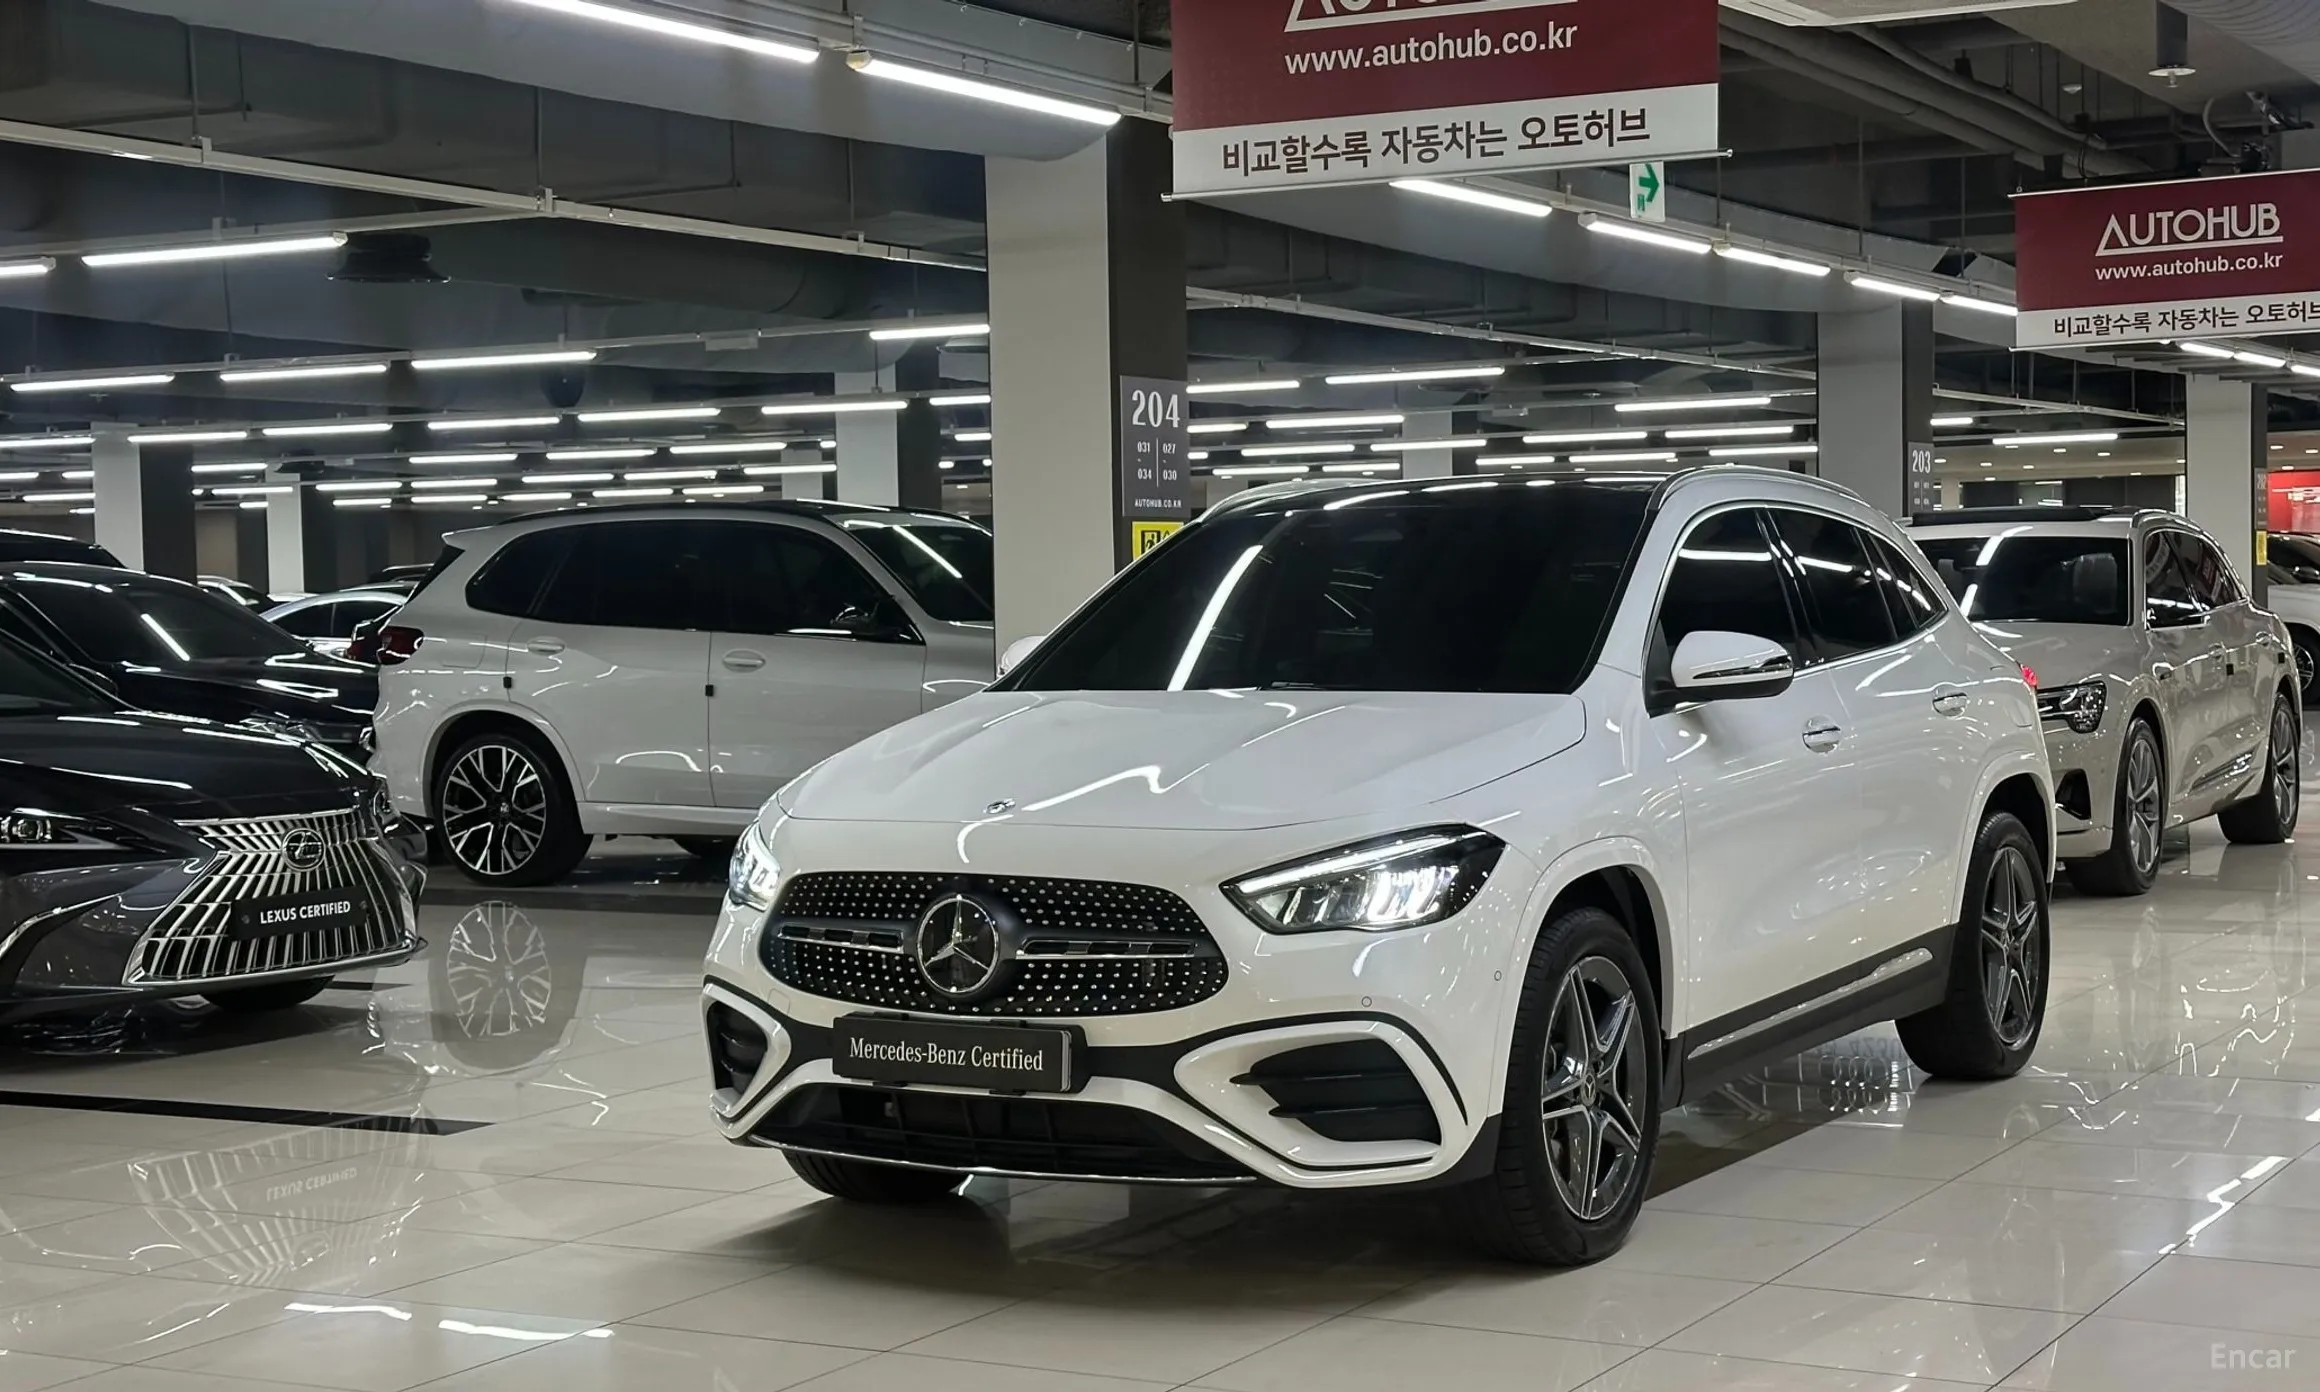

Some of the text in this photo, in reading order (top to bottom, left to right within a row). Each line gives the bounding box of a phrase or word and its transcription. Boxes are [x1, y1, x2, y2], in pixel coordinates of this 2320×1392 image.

[1284, 21, 1578, 74] www.autohub.co.kr
[1222, 108, 1651, 176] 비교할수록 자동차는 오토허브
[2096, 203, 2284, 256] AUTOHUB
[2095, 252, 2284, 280] www.autohub.co.kr
[2054, 311, 2151, 337] 비교할수록
[2158, 306, 2240, 331] 자동차는
[1131, 389, 1180, 428] 204
[1137, 441, 1151, 453] 031
[1162, 443, 1176, 454] 027
[1912, 449, 1931, 473] 203
[1137, 468, 1152, 480] 034
[1162, 470, 1177, 481] 030
[260, 901, 351, 924] LEXUS CERTIFIED
[849, 1037, 1043, 1071] Mercedes-Benz Certified
